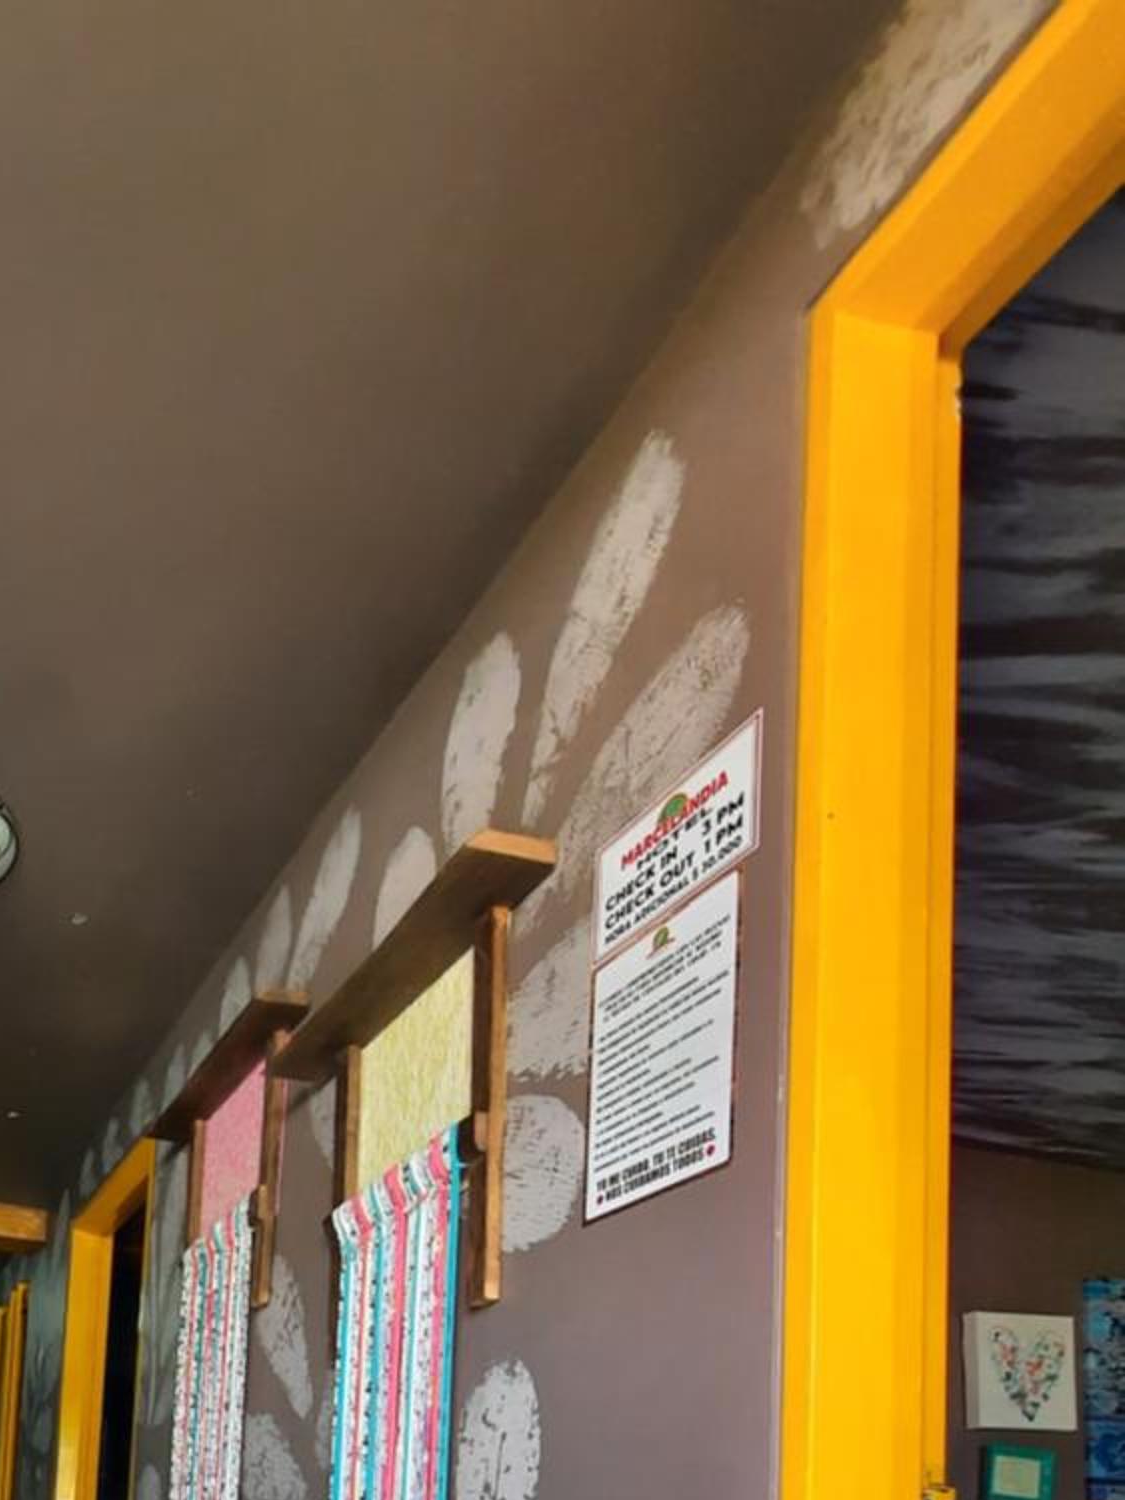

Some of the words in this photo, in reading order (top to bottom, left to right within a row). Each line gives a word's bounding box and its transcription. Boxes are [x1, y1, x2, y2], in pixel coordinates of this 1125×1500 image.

[605, 884, 654, 929] CHECK
[660, 851, 695, 887] OUT
[705, 839, 711, 853] 1
[716, 814, 743, 845] PM
[606, 864, 655, 911] CHECK
[660, 846, 677, 869] IN
[702, 819, 711, 835] 3
[717, 792, 744, 824] PM
